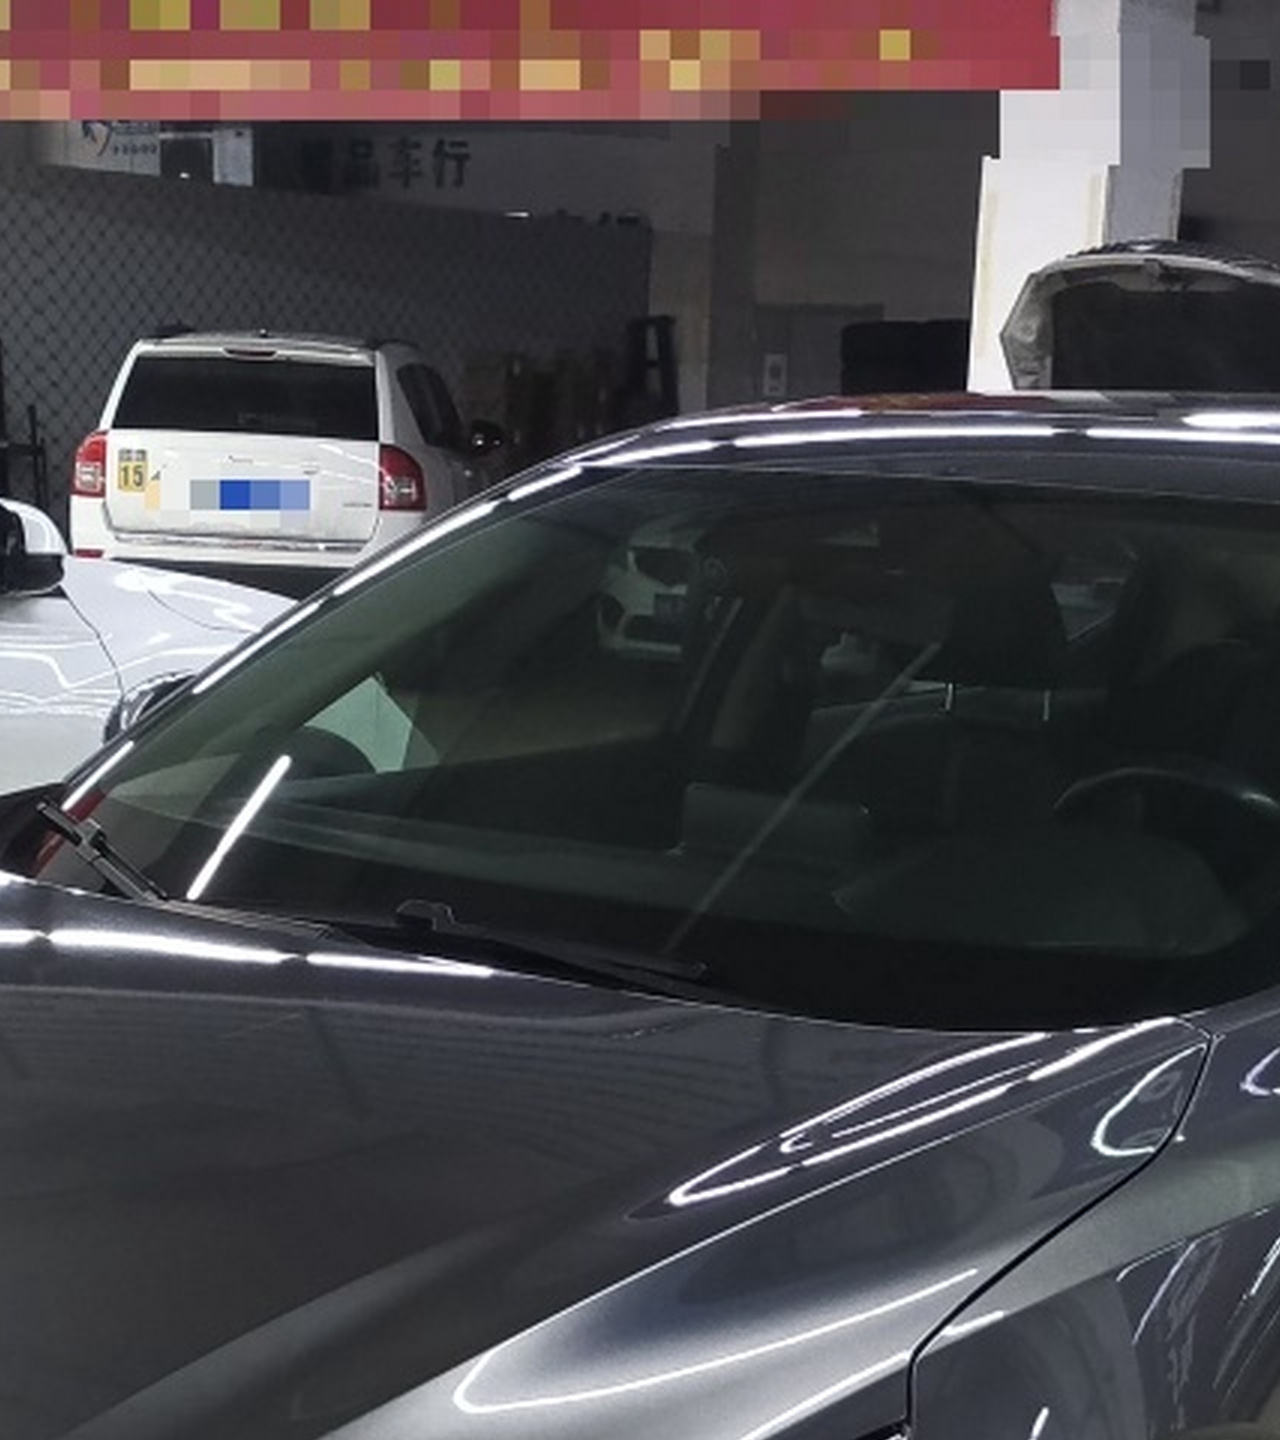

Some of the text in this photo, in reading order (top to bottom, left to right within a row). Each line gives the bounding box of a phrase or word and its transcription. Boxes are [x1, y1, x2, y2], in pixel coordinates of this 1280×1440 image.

[300, 138, 472, 190] 品车行
[121, 464, 144, 487] 15
